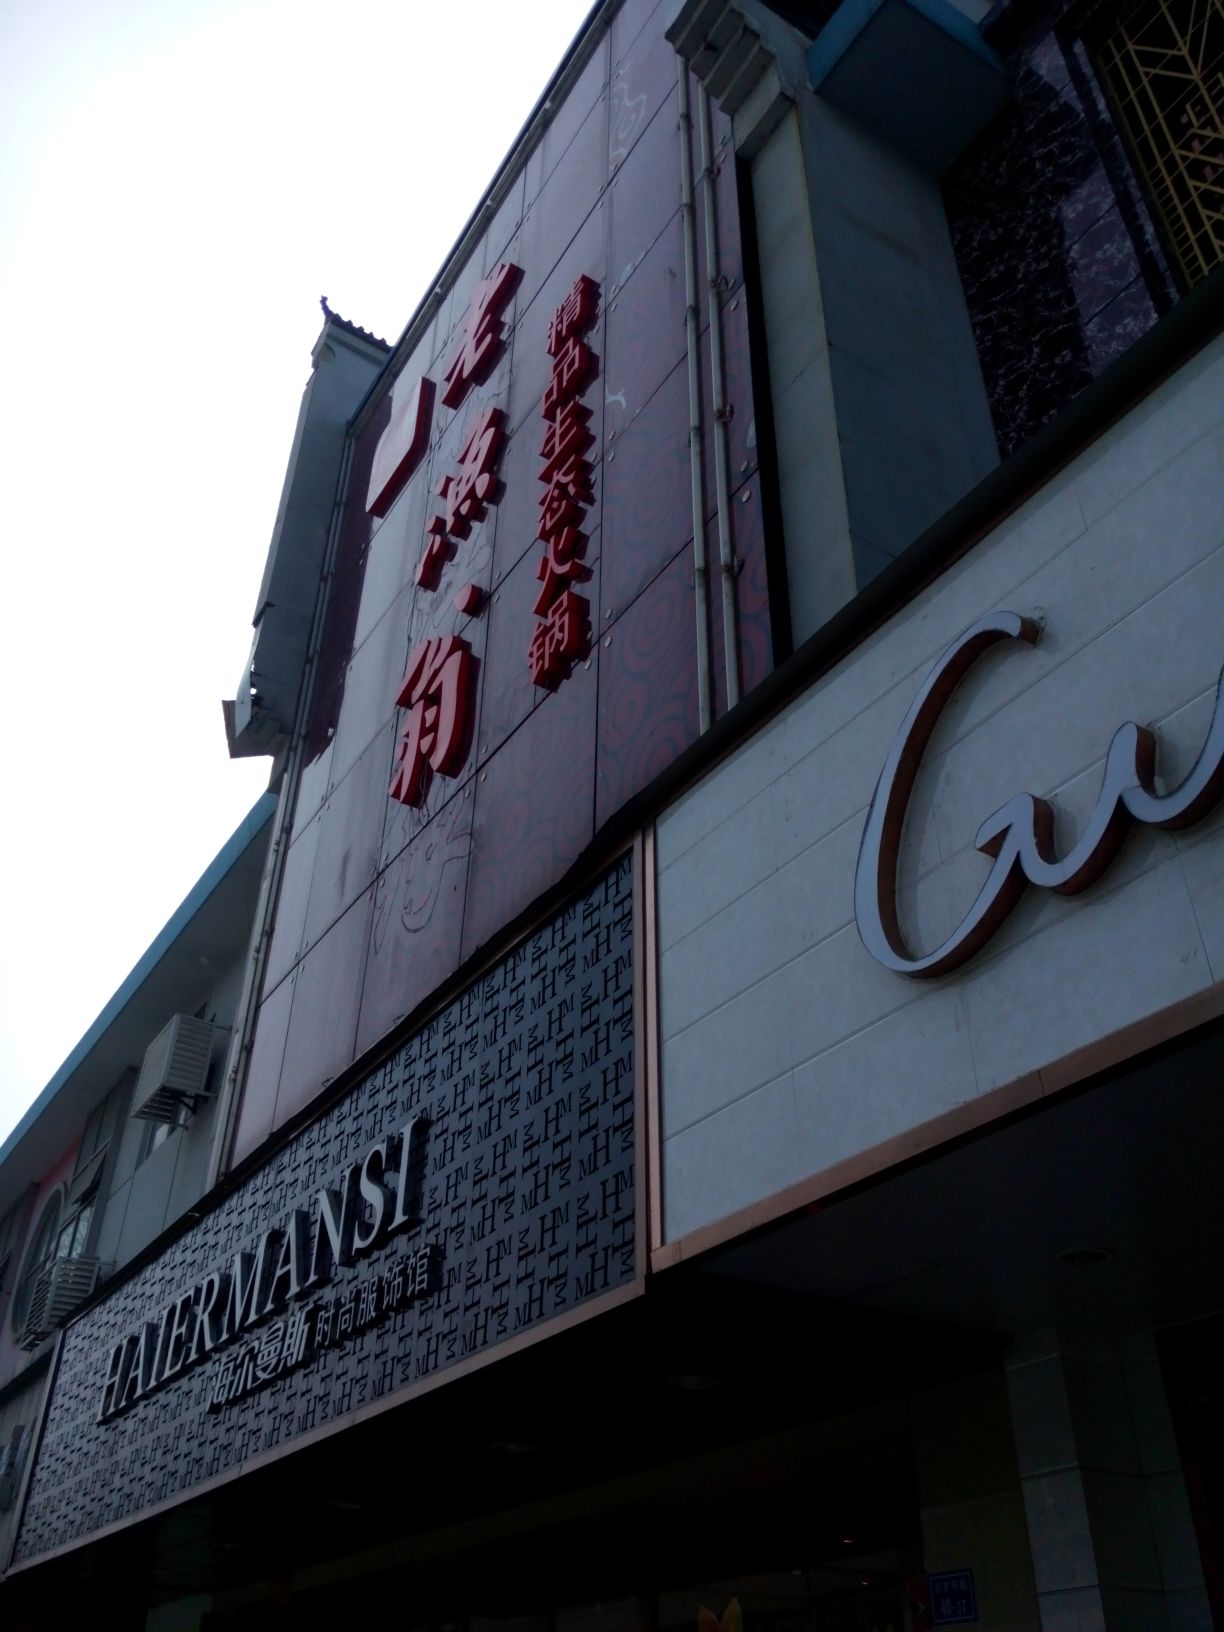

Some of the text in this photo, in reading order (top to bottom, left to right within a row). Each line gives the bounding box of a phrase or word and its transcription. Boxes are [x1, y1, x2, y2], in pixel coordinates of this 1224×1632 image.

[529, 276, 597, 689] 精品生态火锅
[97, 1116, 430, 1421] HAIERMANSI
